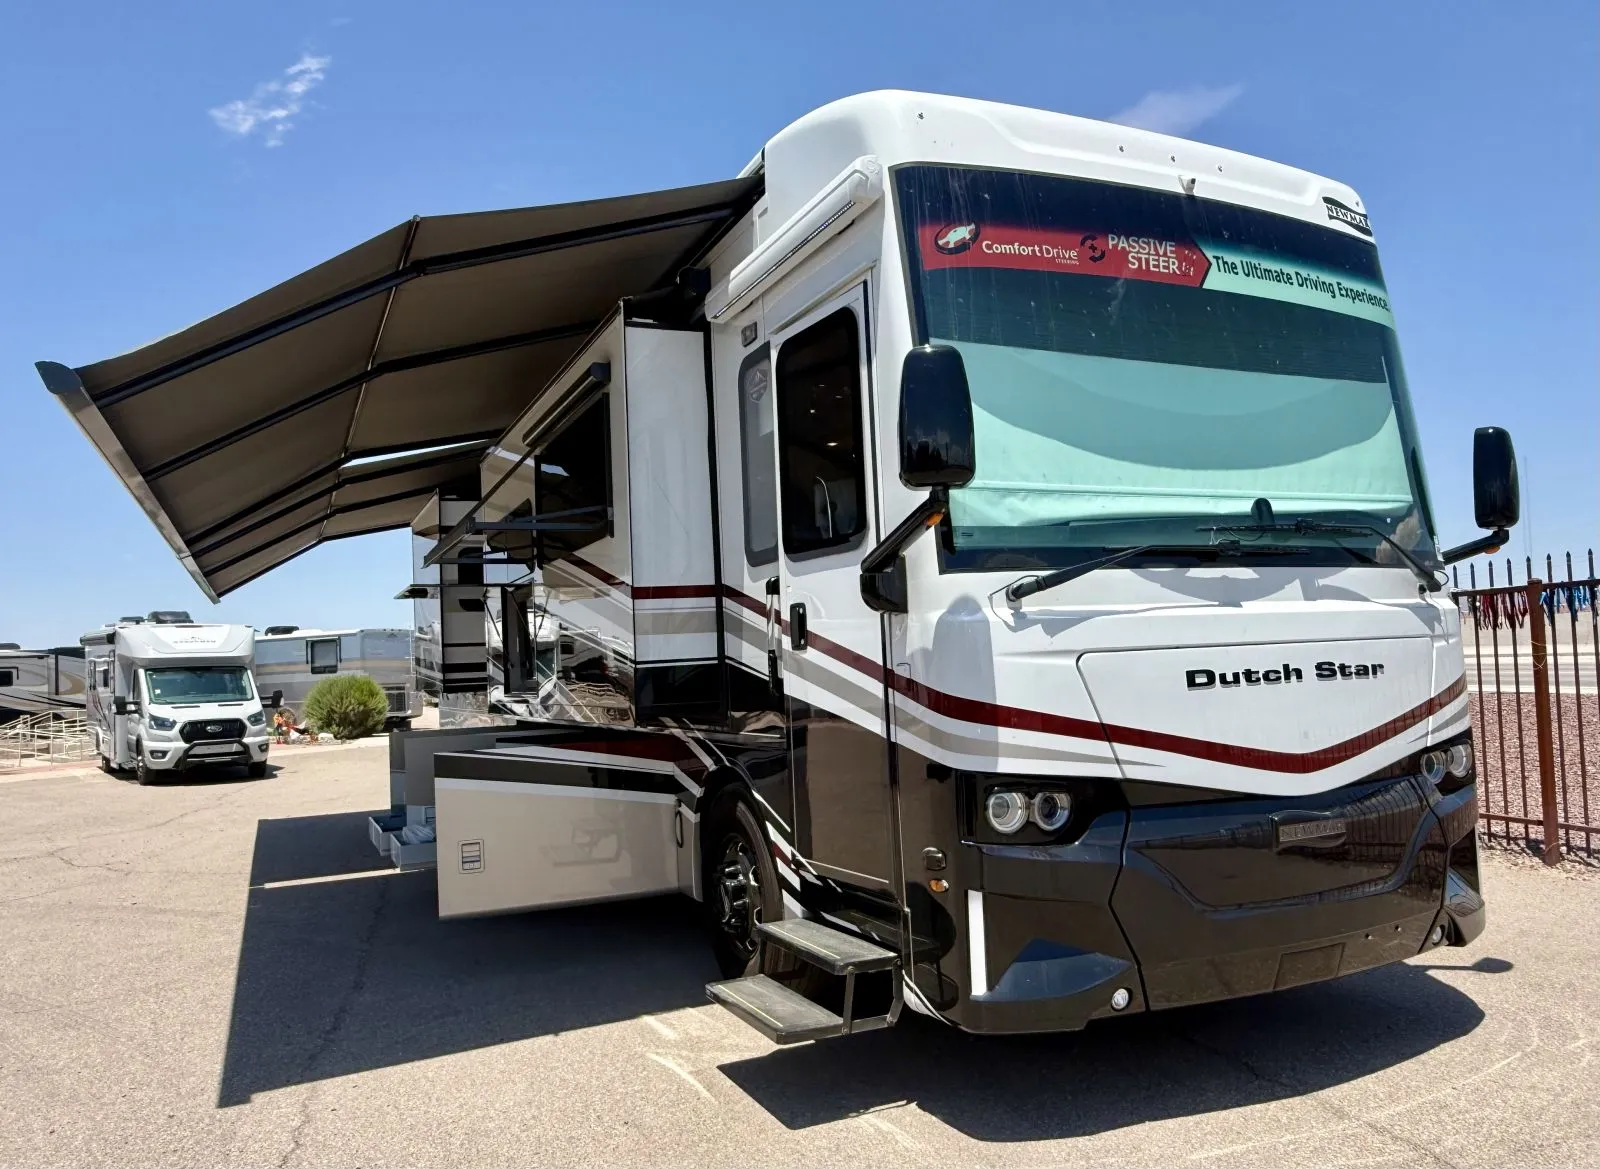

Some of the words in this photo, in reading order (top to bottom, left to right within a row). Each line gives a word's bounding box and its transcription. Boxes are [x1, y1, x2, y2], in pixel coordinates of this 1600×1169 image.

[981, 240, 1041, 257] Comfort
[1042, 244, 1079, 260] Drive
[1107, 233, 1177, 257] PASSIVE
[1127, 252, 1181, 275] STEER
[1212, 254, 1239, 276] The
[1239, 258, 1294, 286] Ultimate
[1294, 270, 1336, 299] Driving
[1185, 663, 1304, 692] Dutch
[1314, 660, 1385, 682] Star
